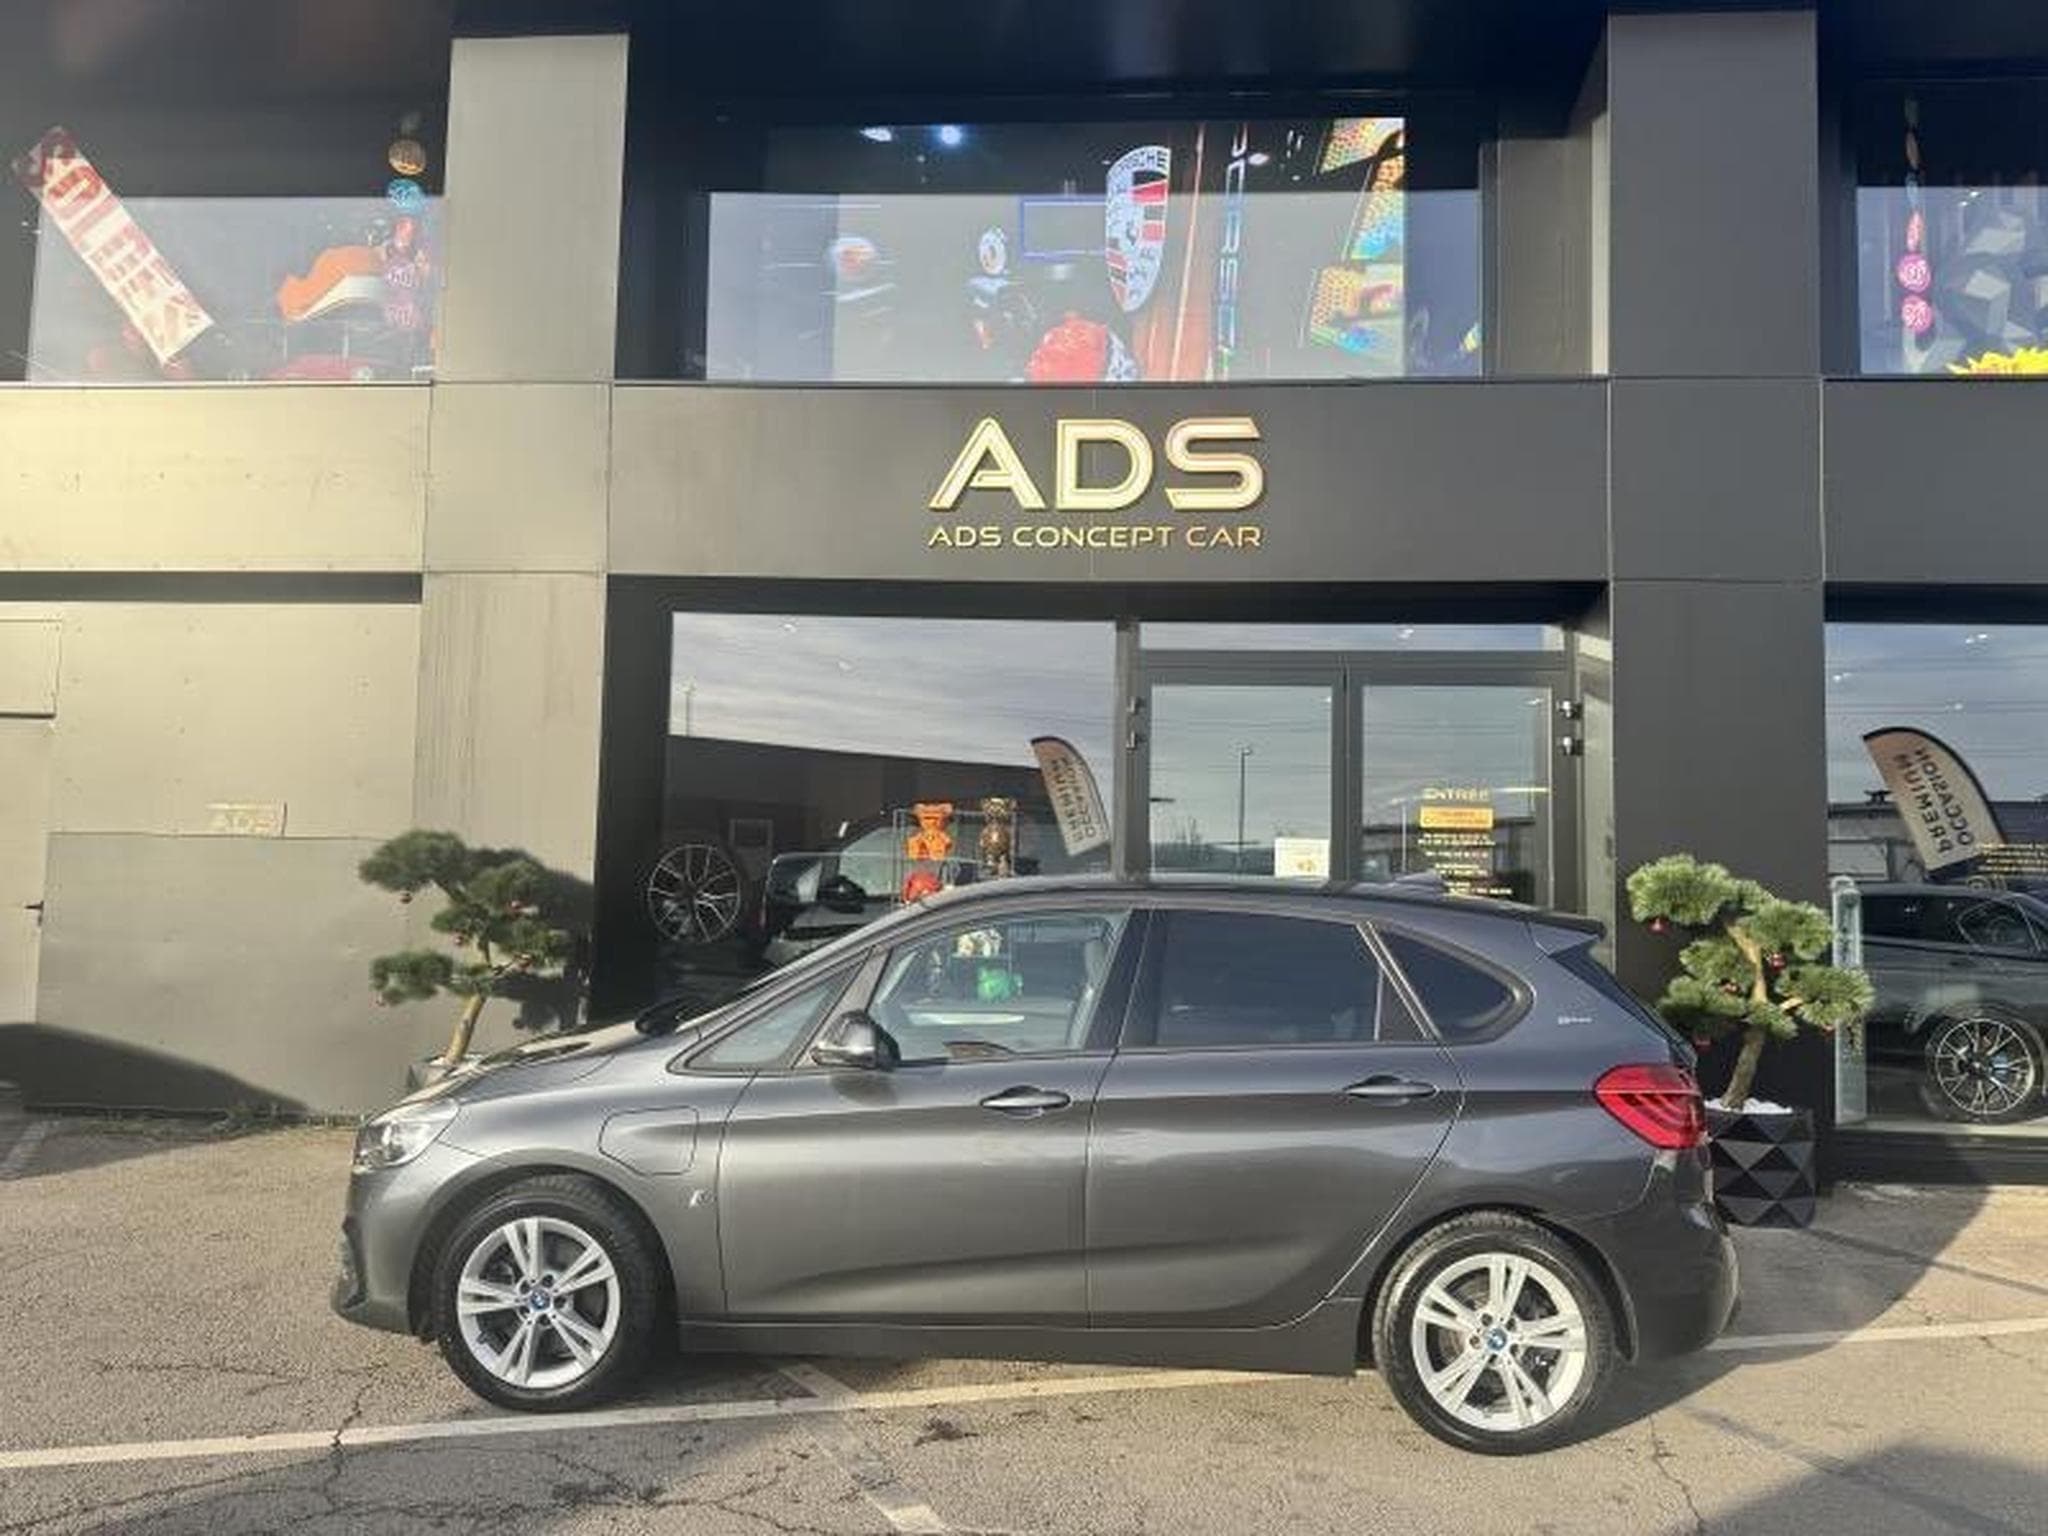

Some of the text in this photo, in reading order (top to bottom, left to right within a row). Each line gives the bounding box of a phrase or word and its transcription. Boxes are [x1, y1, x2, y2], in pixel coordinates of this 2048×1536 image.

[928, 417, 1264, 511] ADS
[928, 525, 1263, 548] ADS CONCEPT CAR
